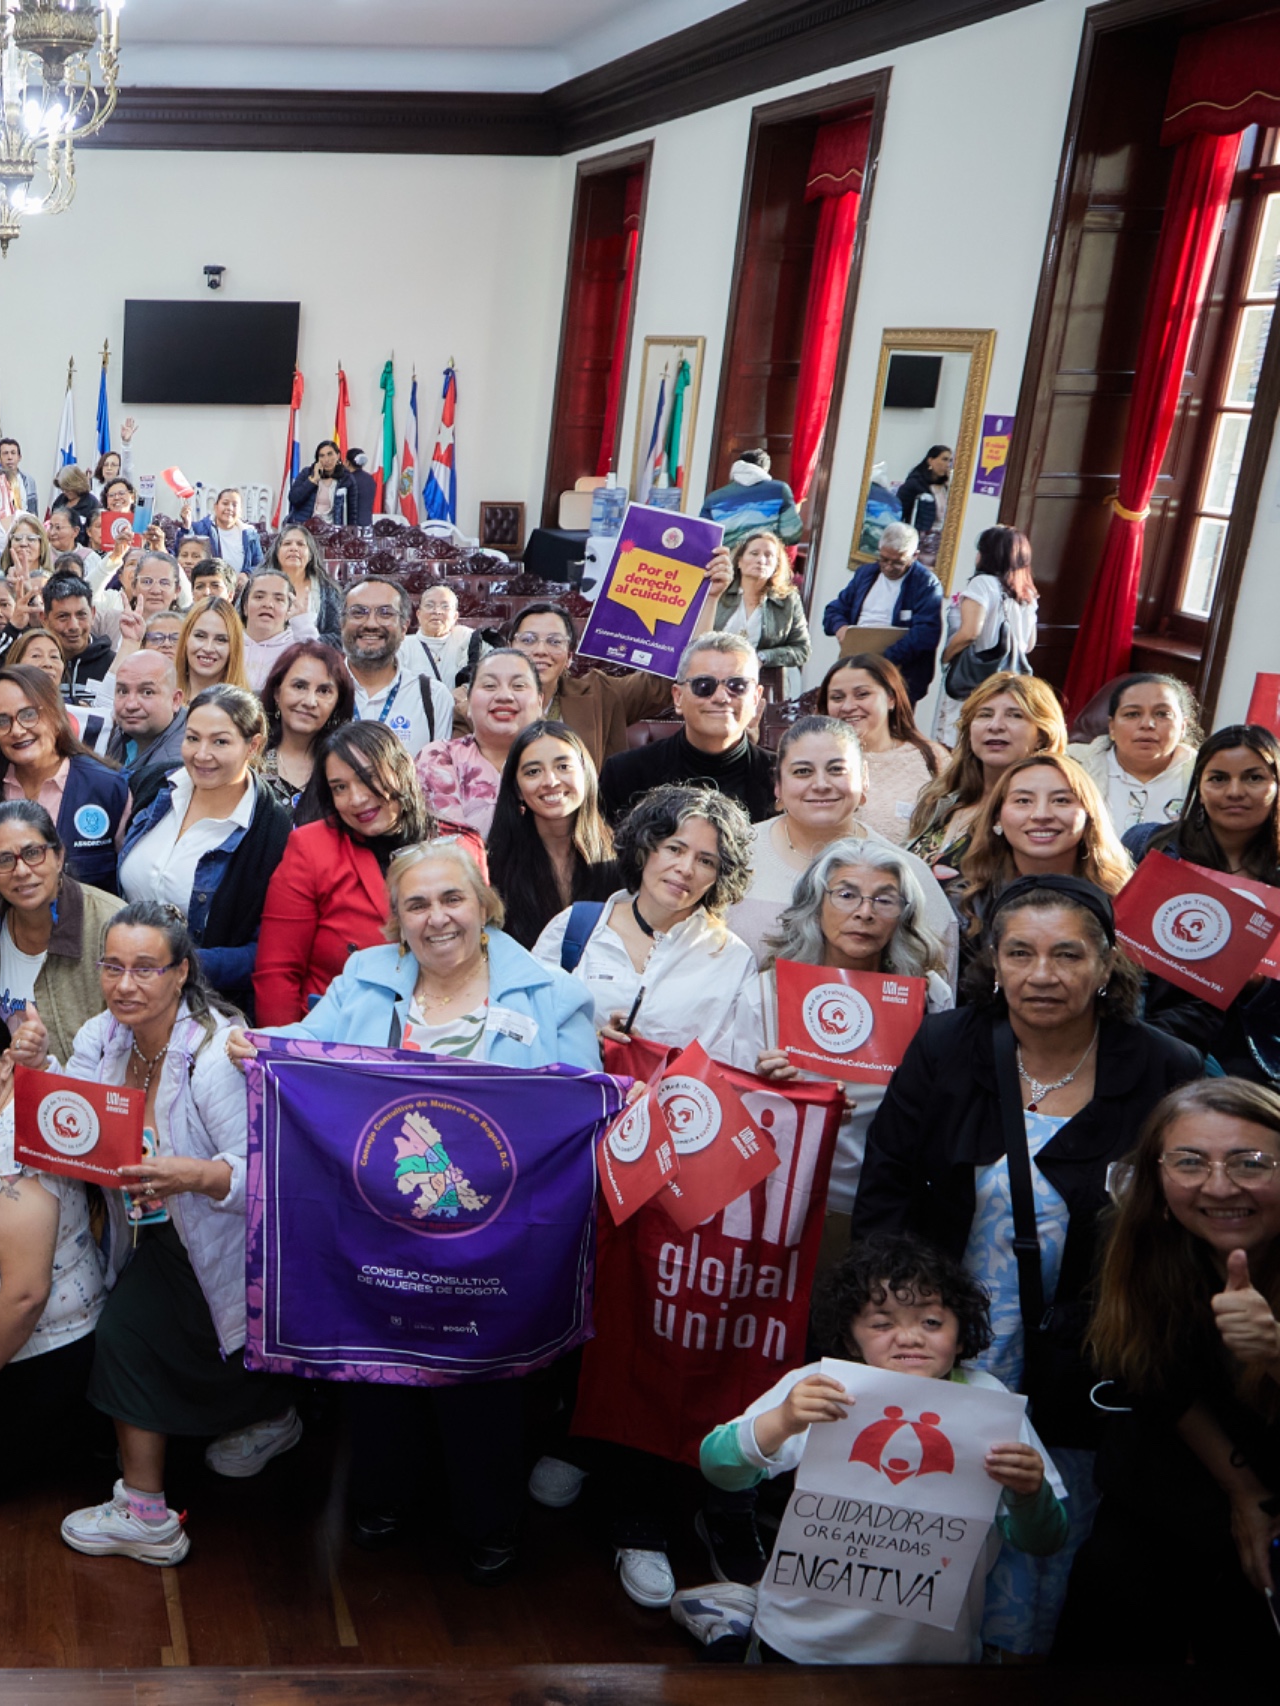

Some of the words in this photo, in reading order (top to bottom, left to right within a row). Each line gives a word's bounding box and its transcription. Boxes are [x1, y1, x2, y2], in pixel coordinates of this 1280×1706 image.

[625, 572, 682, 593] derecho
[638, 562, 662, 576] Por
[665, 570, 679, 580] el
[615, 584, 629, 594] al
[630, 588, 687, 607] cuidado
[360, 1131, 376, 1167] Consejo
[373, 1103, 414, 1131] Consultivo
[416, 1100, 427, 1108] de
[430, 1099, 467, 1116] Mujeres
[468, 1113, 480, 1123] de
[361, 1265, 420, 1280] CONSEJO
[421, 1273, 501, 1286] CONSULTIVO
[658, 1233, 799, 1303] global
[357, 1274, 373, 1285] DE
[375, 1278, 433, 1294] MUJERES
[436, 1285, 453, 1295] DE
[653, 1299, 787, 1360] union
[793, 1493, 967, 1543] CUIDADORAS
[804, 1523, 931, 1557] ORGANIZADAS
[846, 1545, 869, 1560] DE
[772, 1550, 942, 1612] ENGATIVÁ
